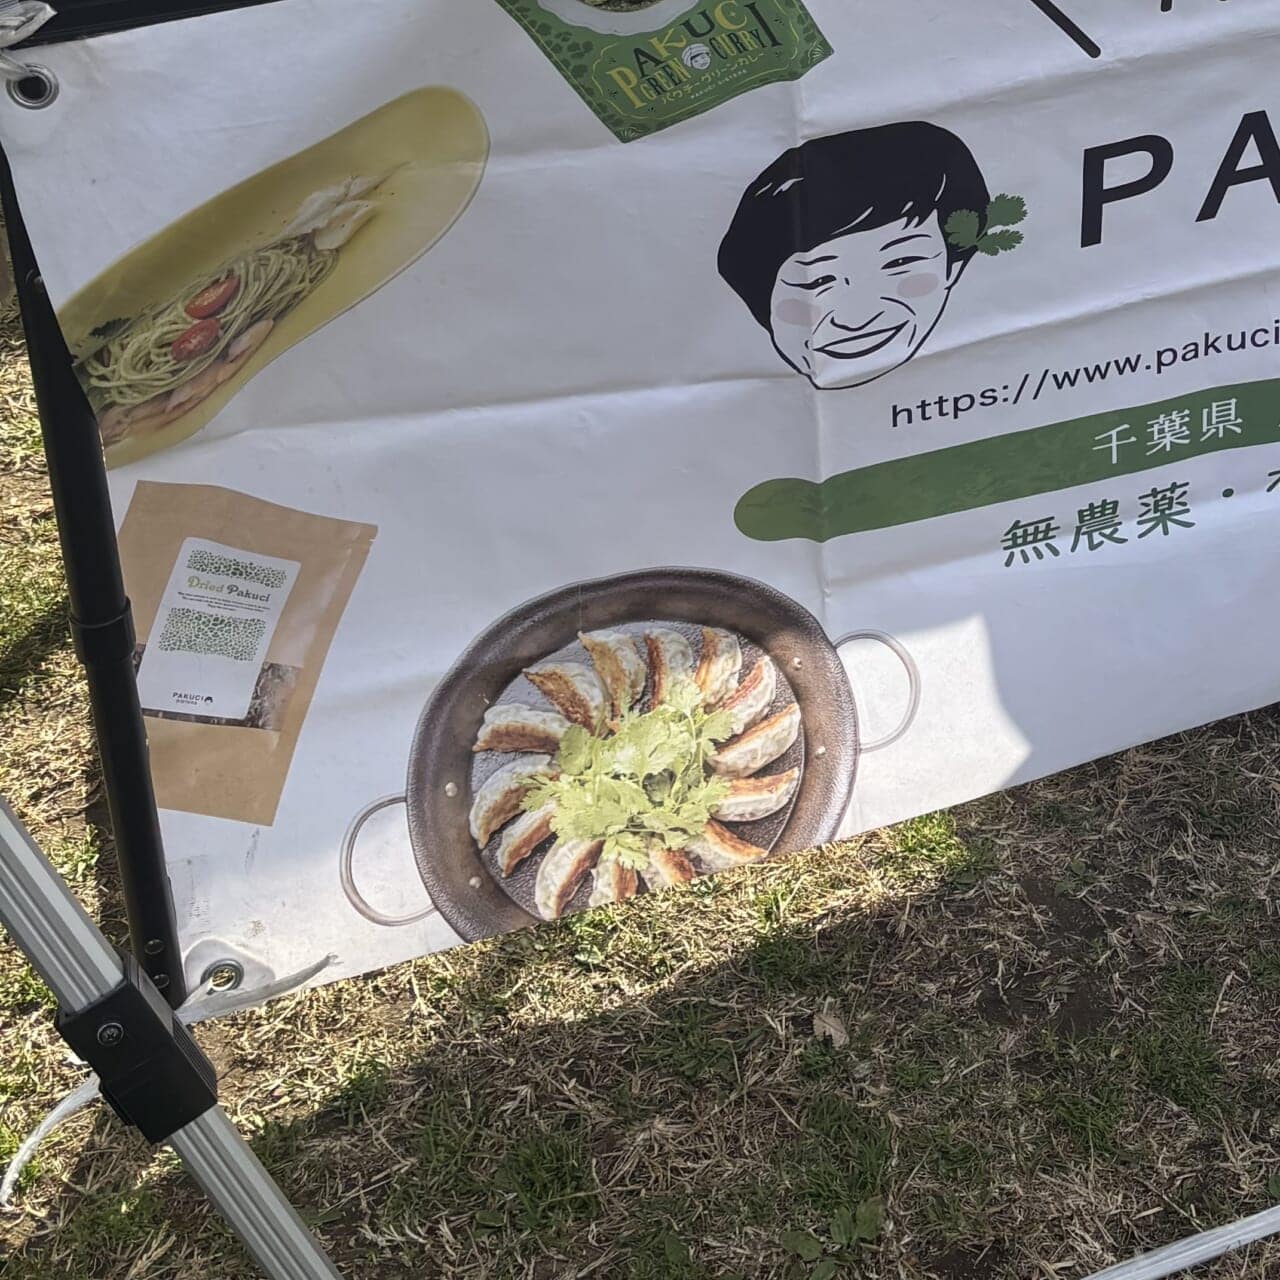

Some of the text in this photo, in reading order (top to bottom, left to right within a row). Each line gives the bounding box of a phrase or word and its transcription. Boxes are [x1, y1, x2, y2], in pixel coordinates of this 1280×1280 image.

[1091, 397, 1244, 467] 千葉県
[187, 575, 271, 602] Dried Pakuci
